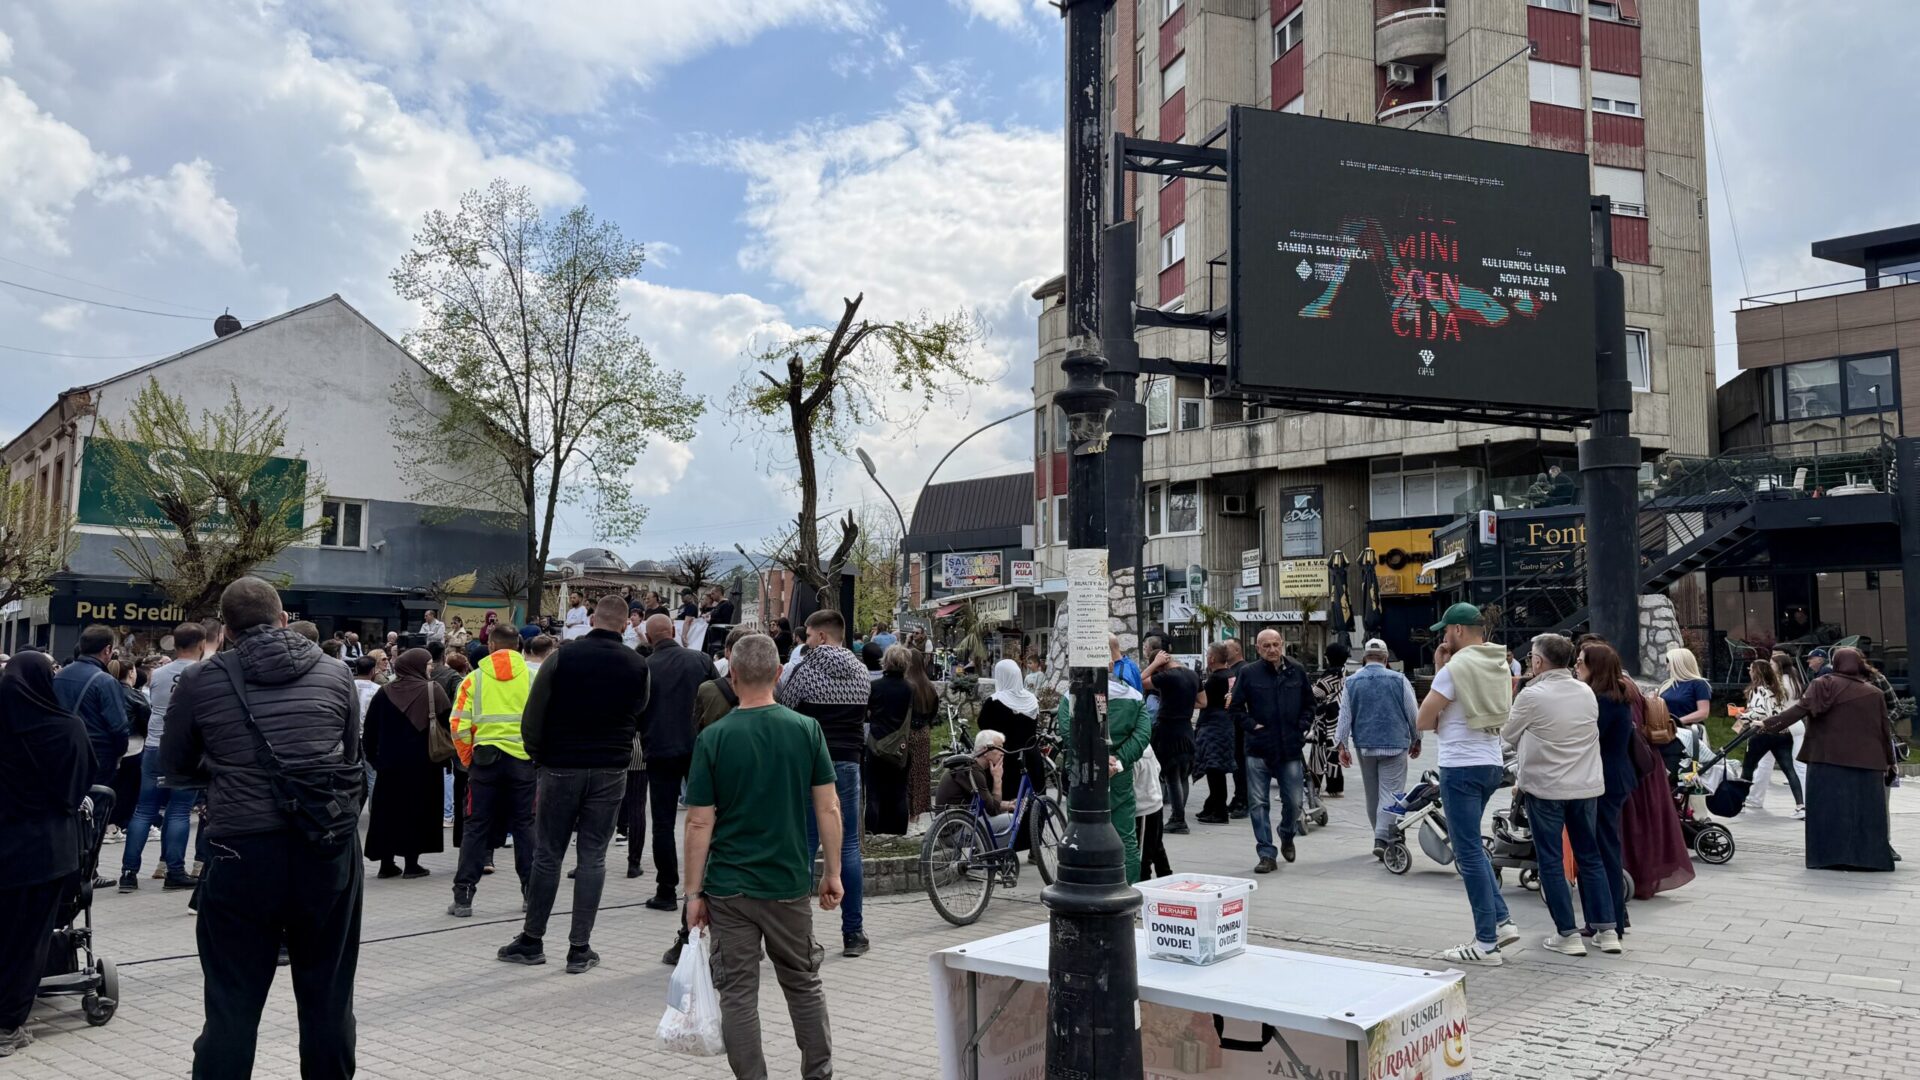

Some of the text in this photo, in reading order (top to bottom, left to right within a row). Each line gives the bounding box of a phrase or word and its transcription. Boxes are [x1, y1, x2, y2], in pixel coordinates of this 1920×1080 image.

[1277, 241, 1368, 260] SAMIRA SMAJOVIĆA
[1482, 257, 1532, 271] KULTURNOG
[1499, 272, 1549, 287] NOVI PAZAR
[1492, 286, 1505, 297] 25.
[1508, 288, 1531, 300] APRIL
[1391, 307, 1461, 341] CIJA
[76, 602, 117, 621] Put
[1152, 922, 1195, 937] DONIRAJ
[1217, 919, 1241, 935] DONIRAJ
[1156, 936, 1192, 950] OVDJE!
[1401, 998, 1444, 1036] U SUSRET
